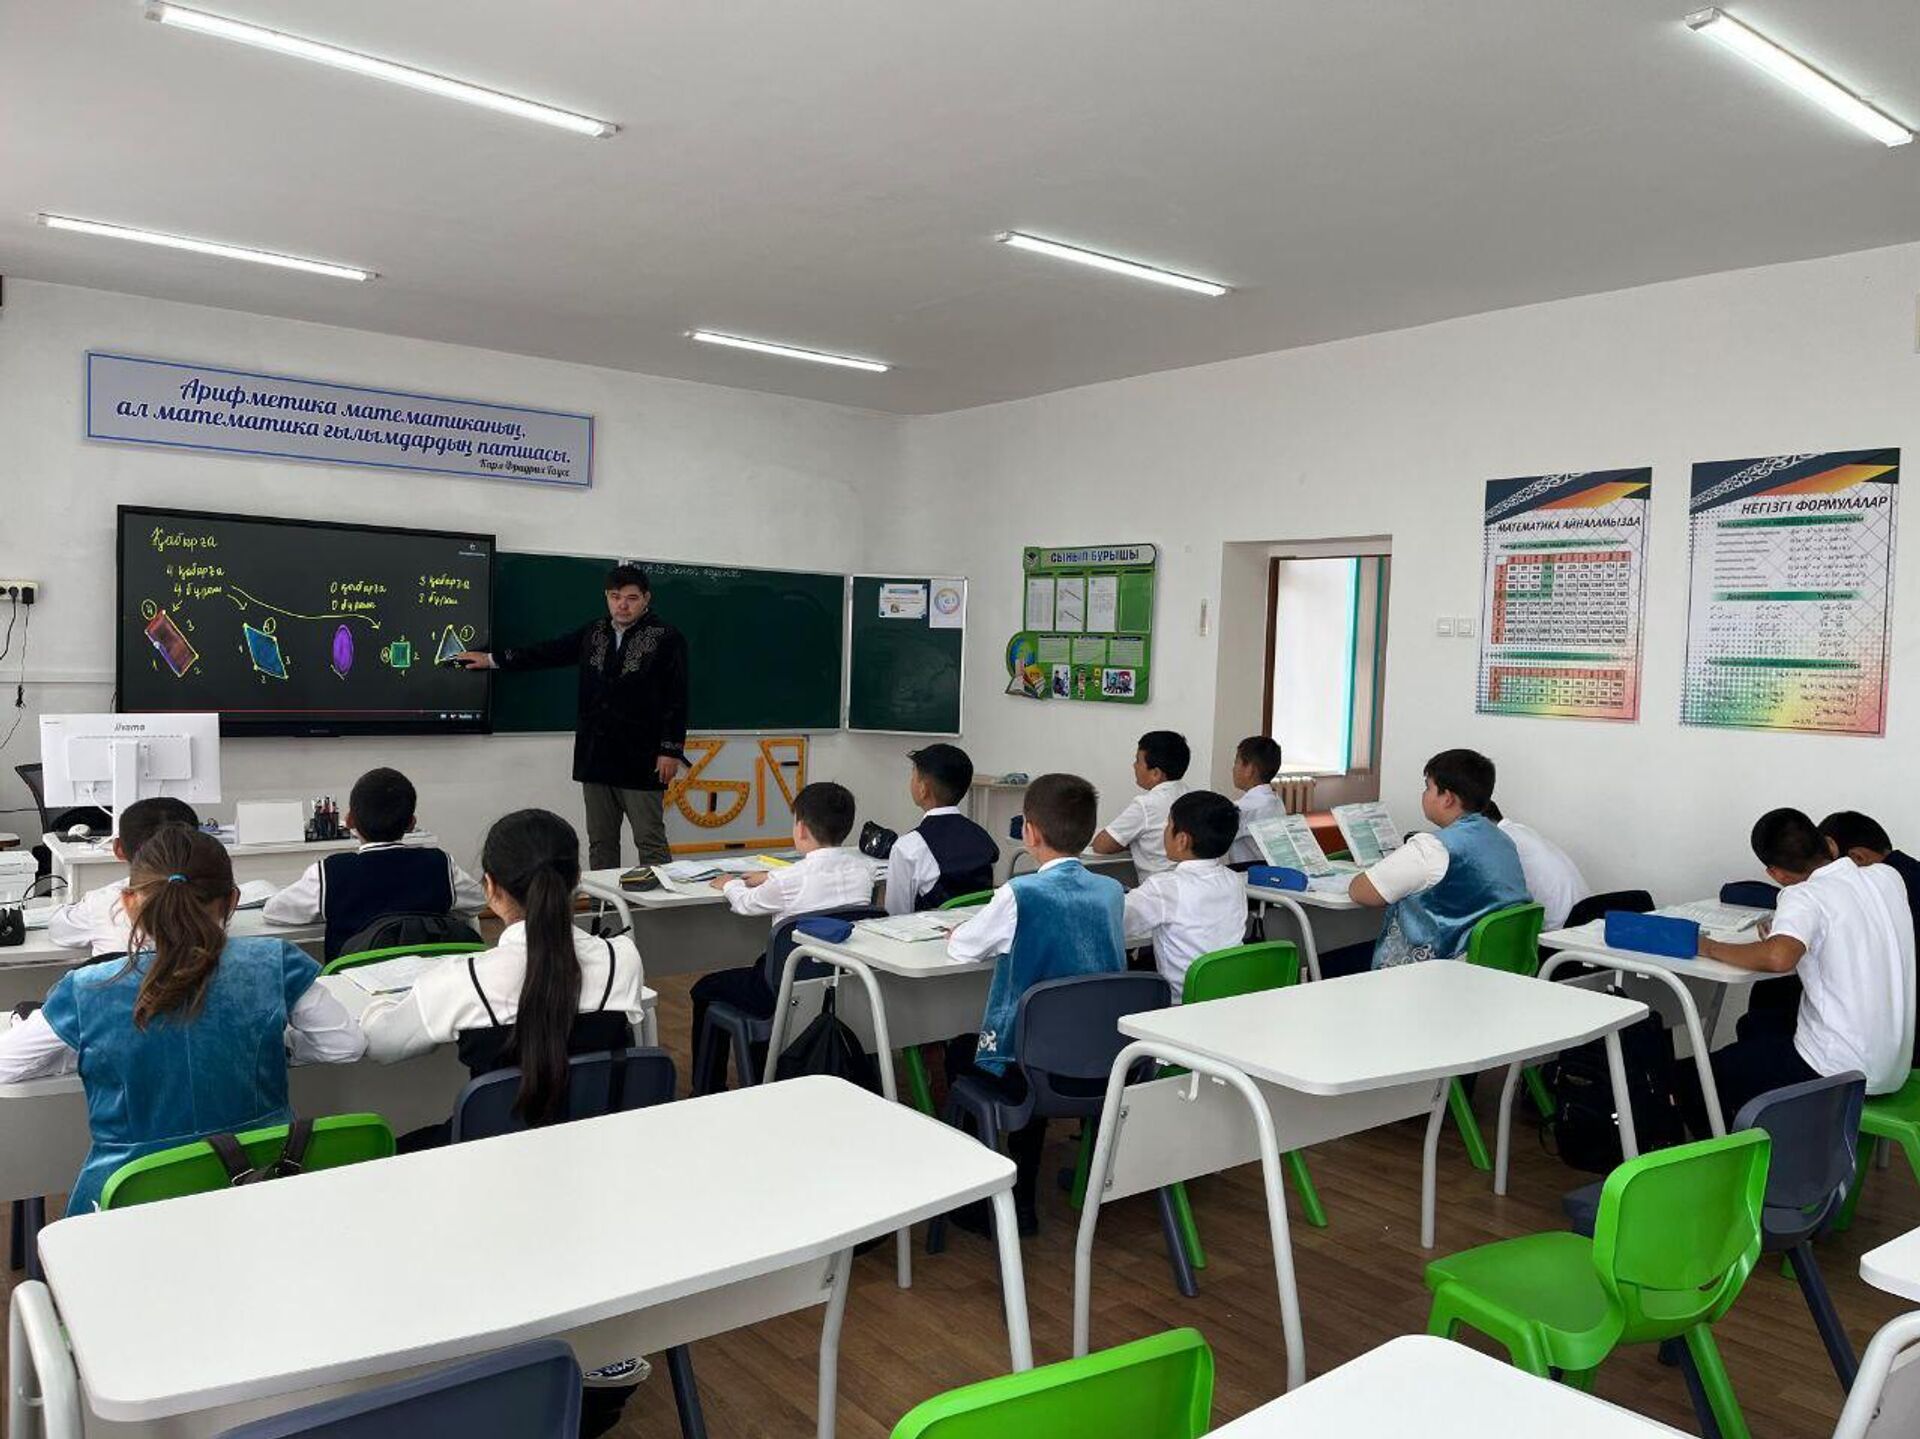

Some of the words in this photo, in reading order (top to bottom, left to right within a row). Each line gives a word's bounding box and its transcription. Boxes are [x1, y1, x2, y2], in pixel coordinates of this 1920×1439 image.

[180, 378, 338, 415] Арифметика
[341, 403, 526, 440] математиканың,
[116, 400, 148, 418] ал
[153, 405, 319, 437] математика
[477, 441, 571, 464] патшасы.
[1497, 520, 1560, 533] МАТЕМАТИКА
[1562, 516, 1641, 530] АЙНАЛАМЫЗДА
[1742, 501, 1792, 515] НЕГІЗГІ
[1796, 496, 1889, 512] ФОРМУЛАЛАР
